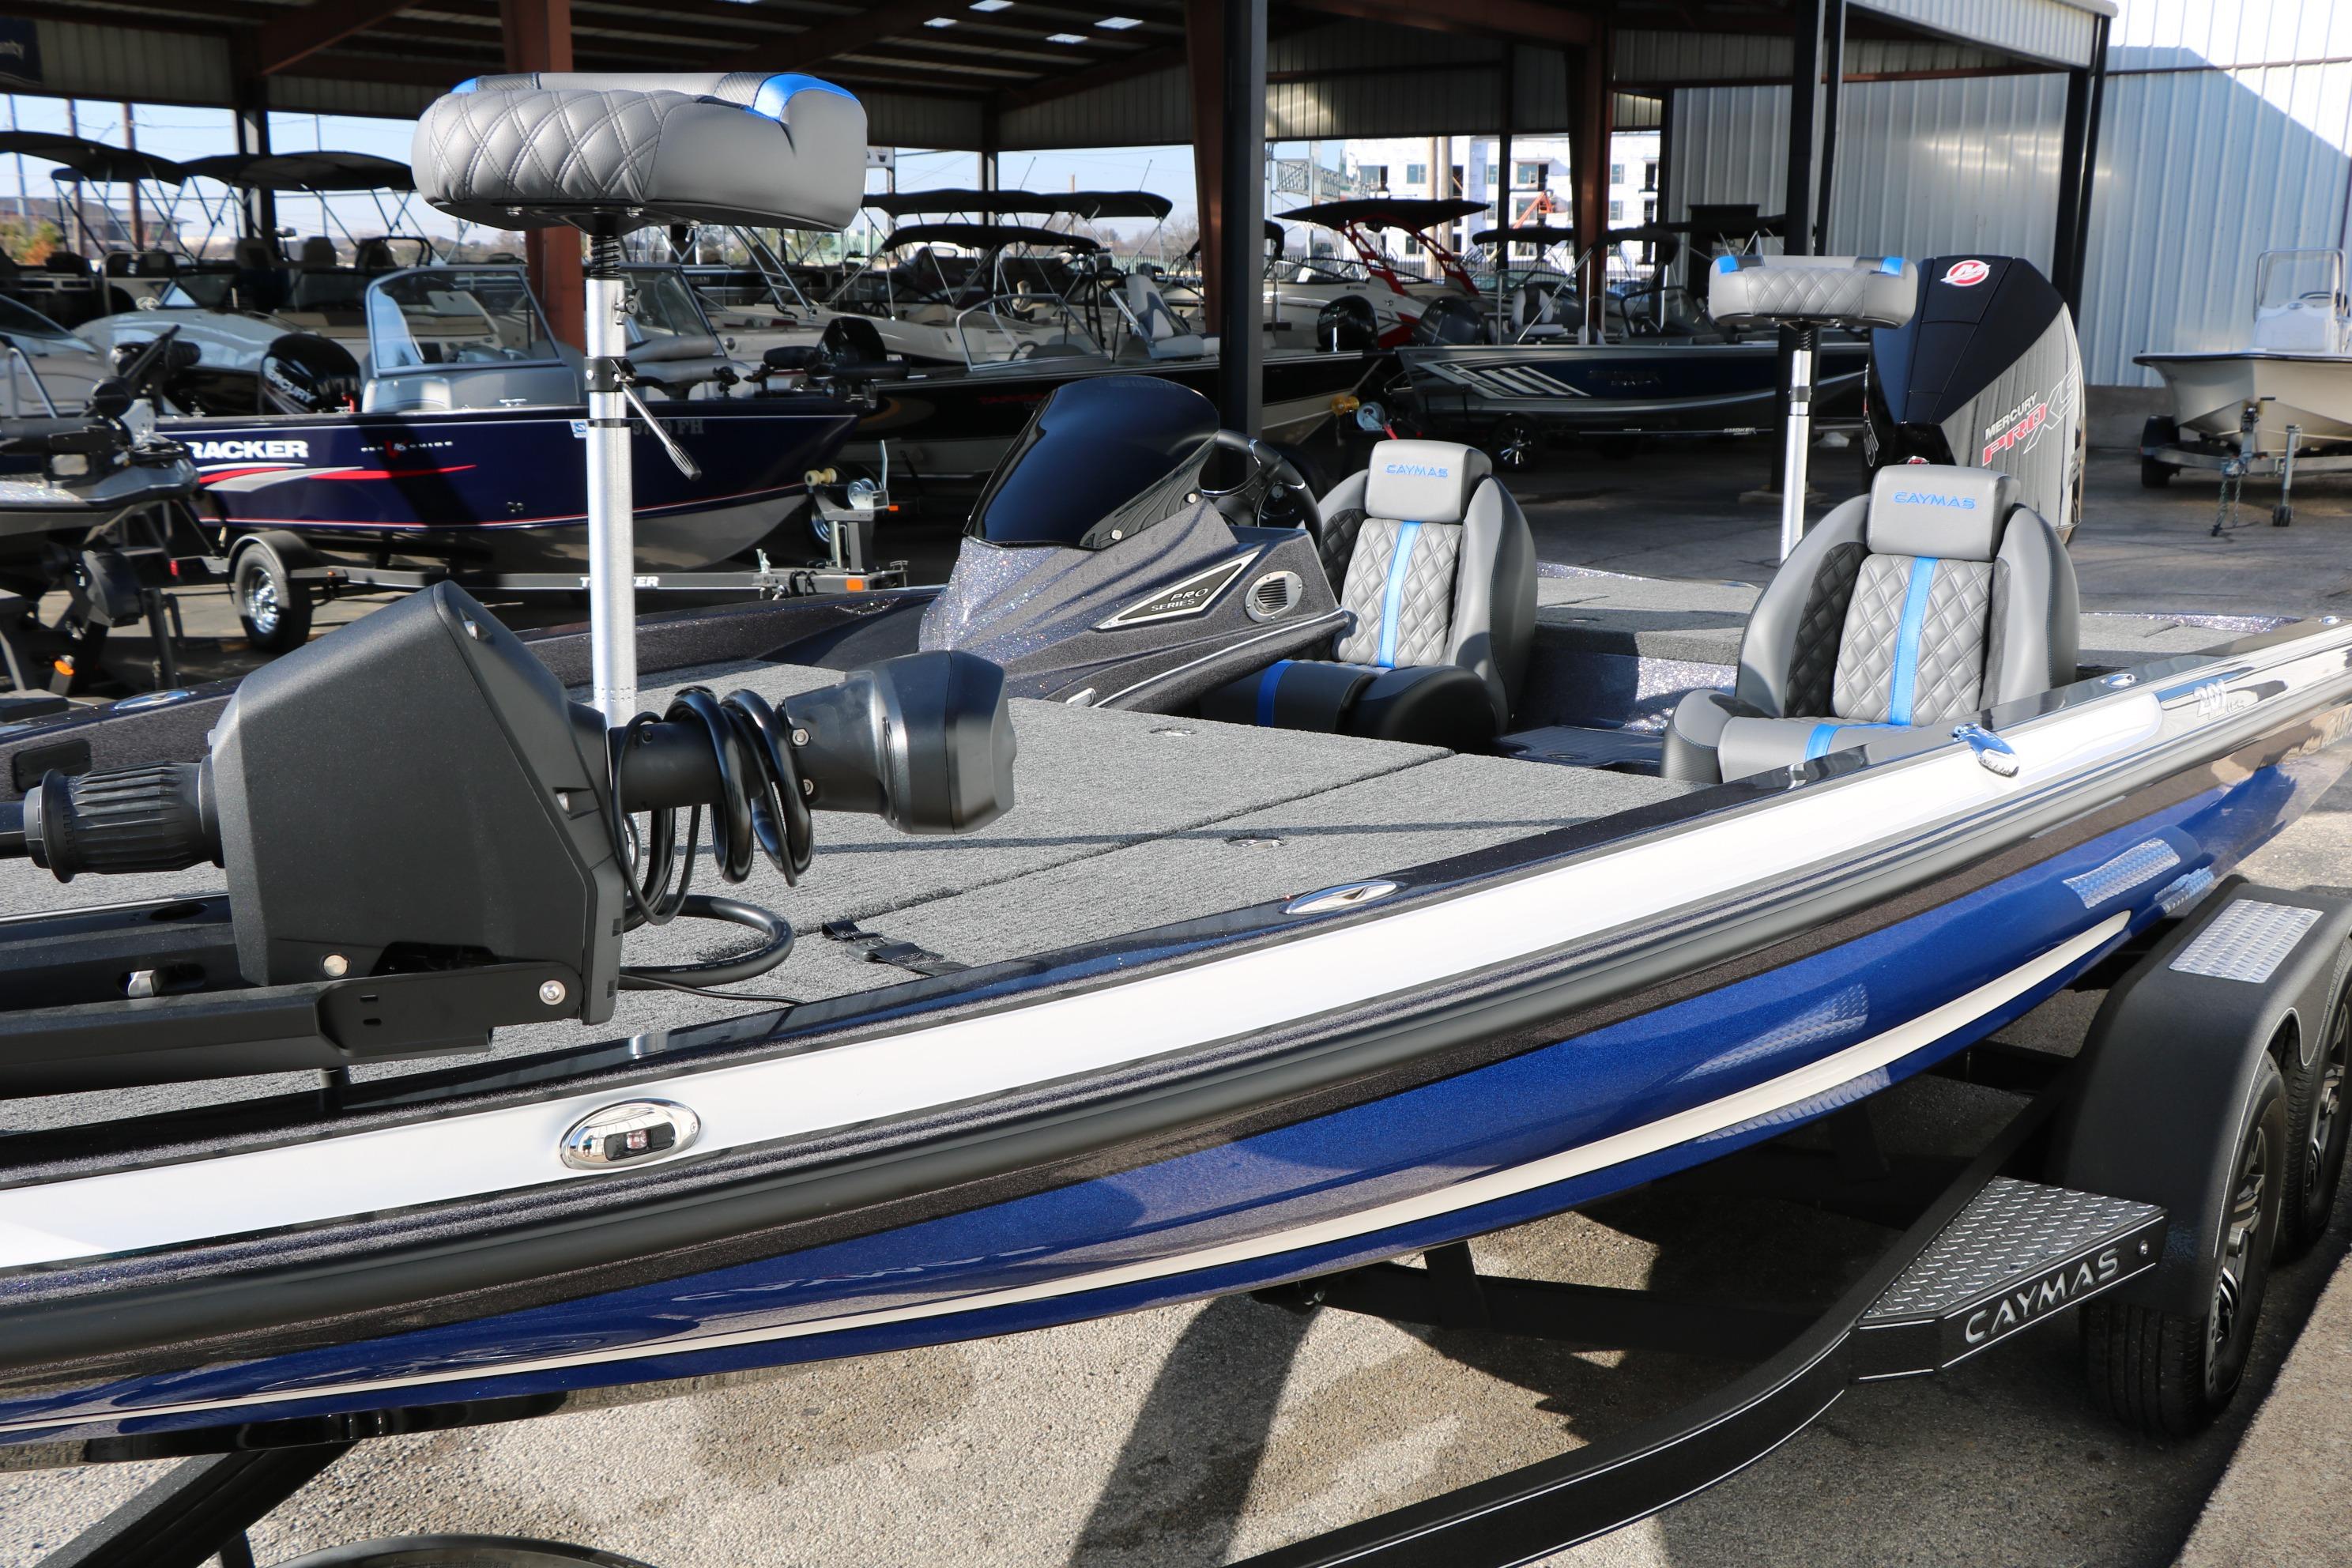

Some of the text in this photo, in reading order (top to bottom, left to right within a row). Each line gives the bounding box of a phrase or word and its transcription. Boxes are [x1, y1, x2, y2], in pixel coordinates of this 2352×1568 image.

[1984, 391, 2037, 441] MERCURY
[1982, 402, 2047, 466] PRO
[185, 440, 310, 458] RACKER
[1386, 463, 1448, 478] CAYMAS
[1894, 492, 1976, 510] CAYMAS
[1170, 588, 1209, 601] PRO
[1151, 598, 1196, 612] SERIES
[1966, 1247, 2121, 1344] CAYMAS
